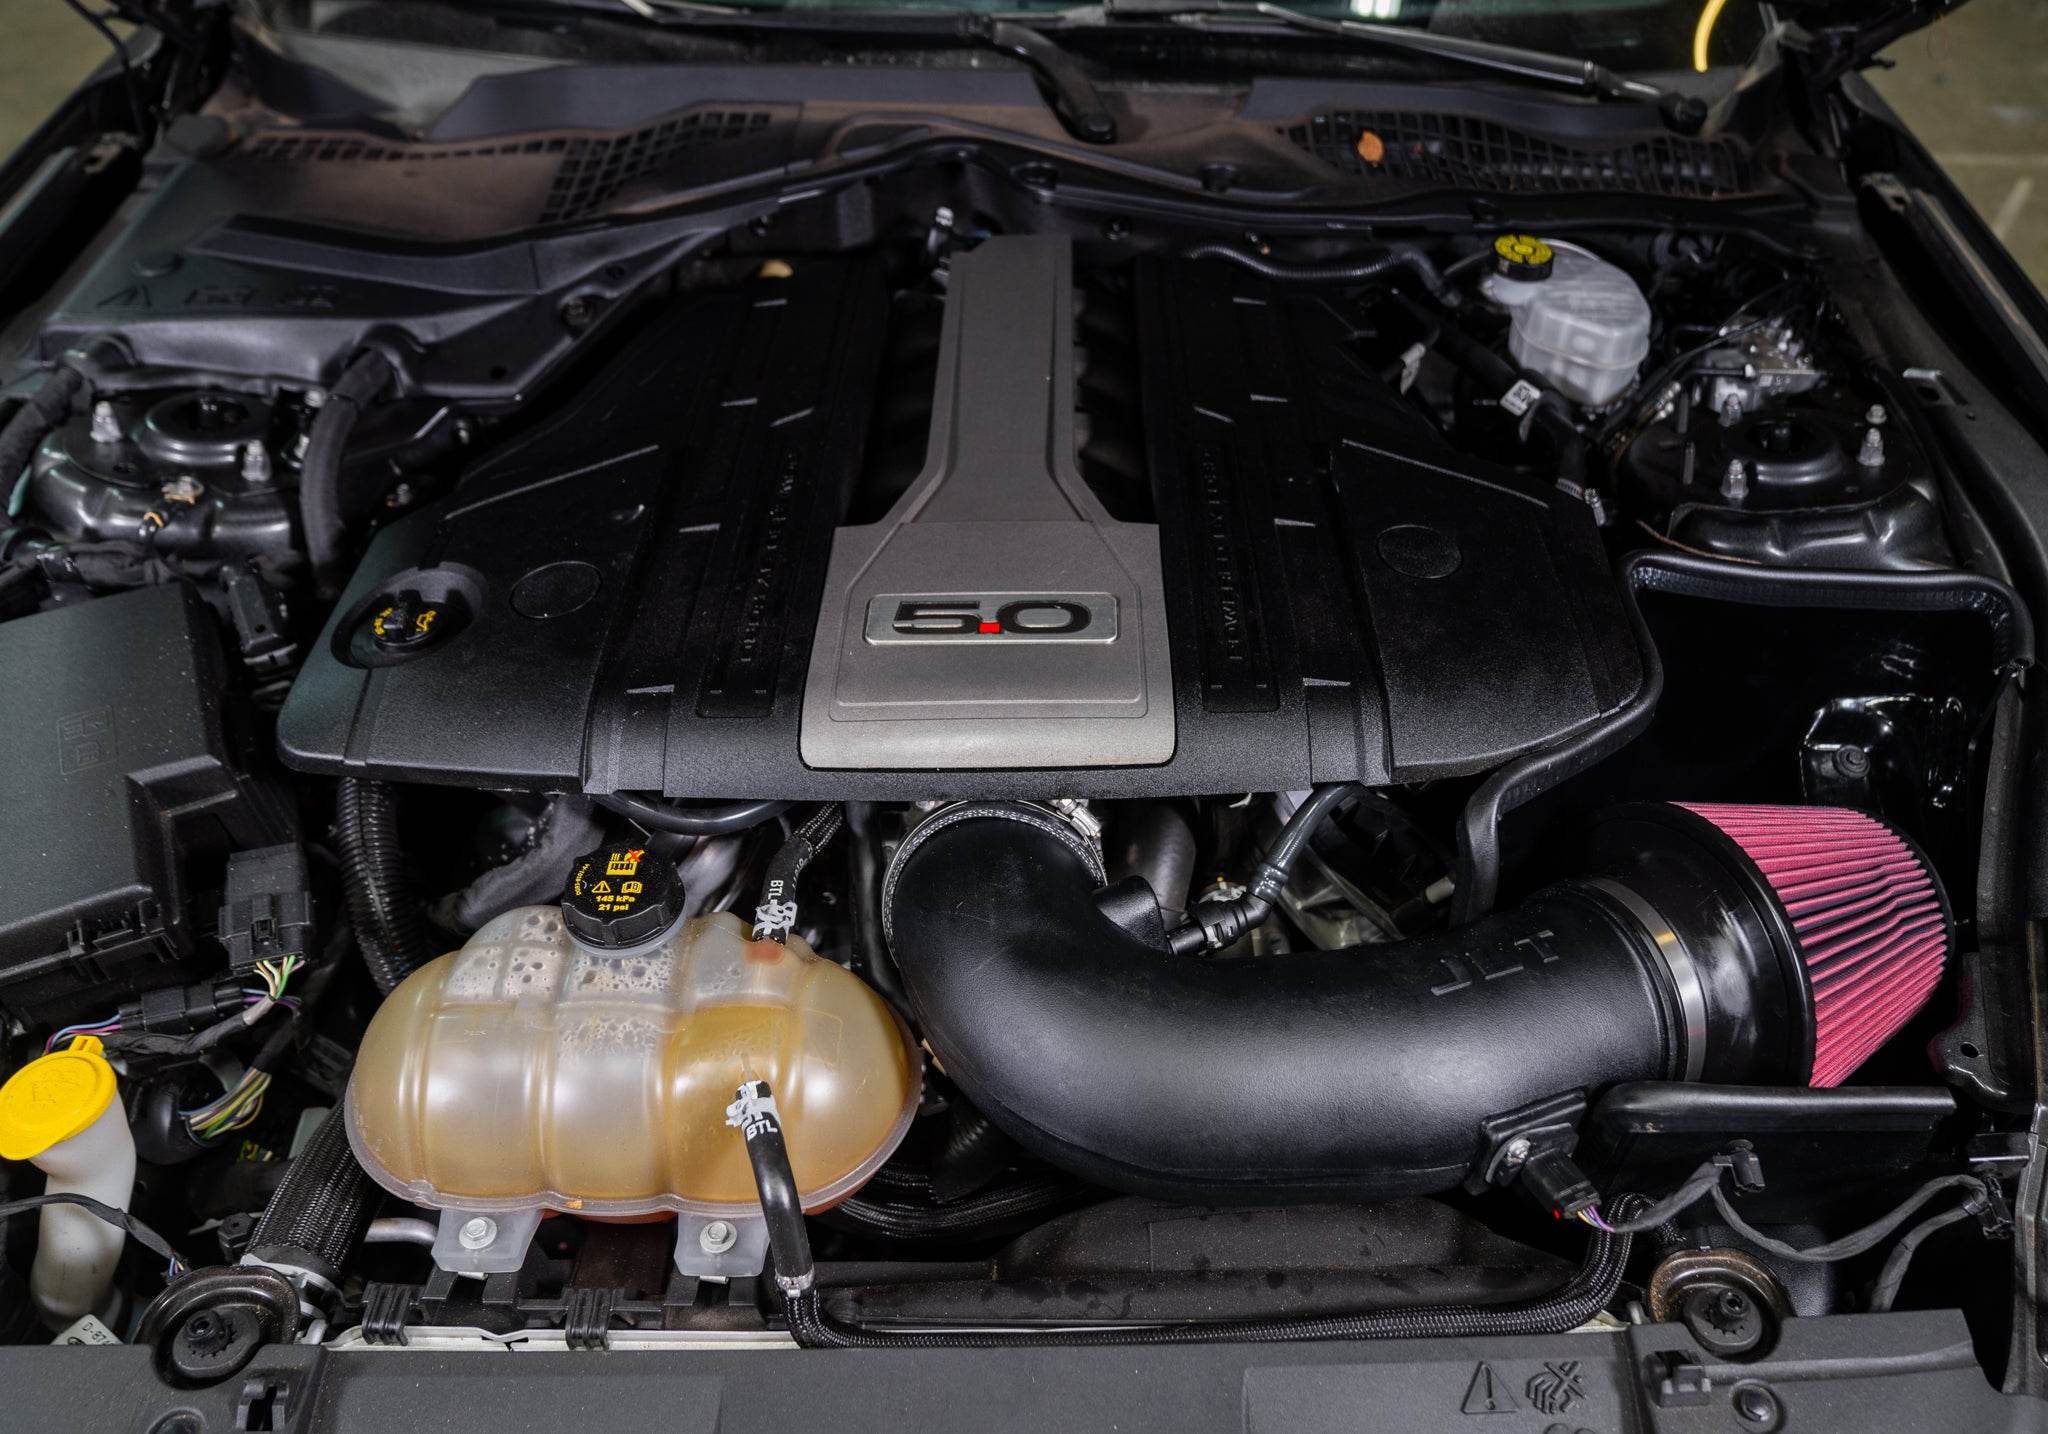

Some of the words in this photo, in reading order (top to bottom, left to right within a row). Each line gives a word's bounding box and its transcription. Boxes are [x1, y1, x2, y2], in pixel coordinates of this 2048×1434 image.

[893, 601, 1092, 635] 5.0
[595, 895, 614, 903] 145
[1430, 929, 1560, 996] JLT
[746, 1119, 778, 1141] BTL
